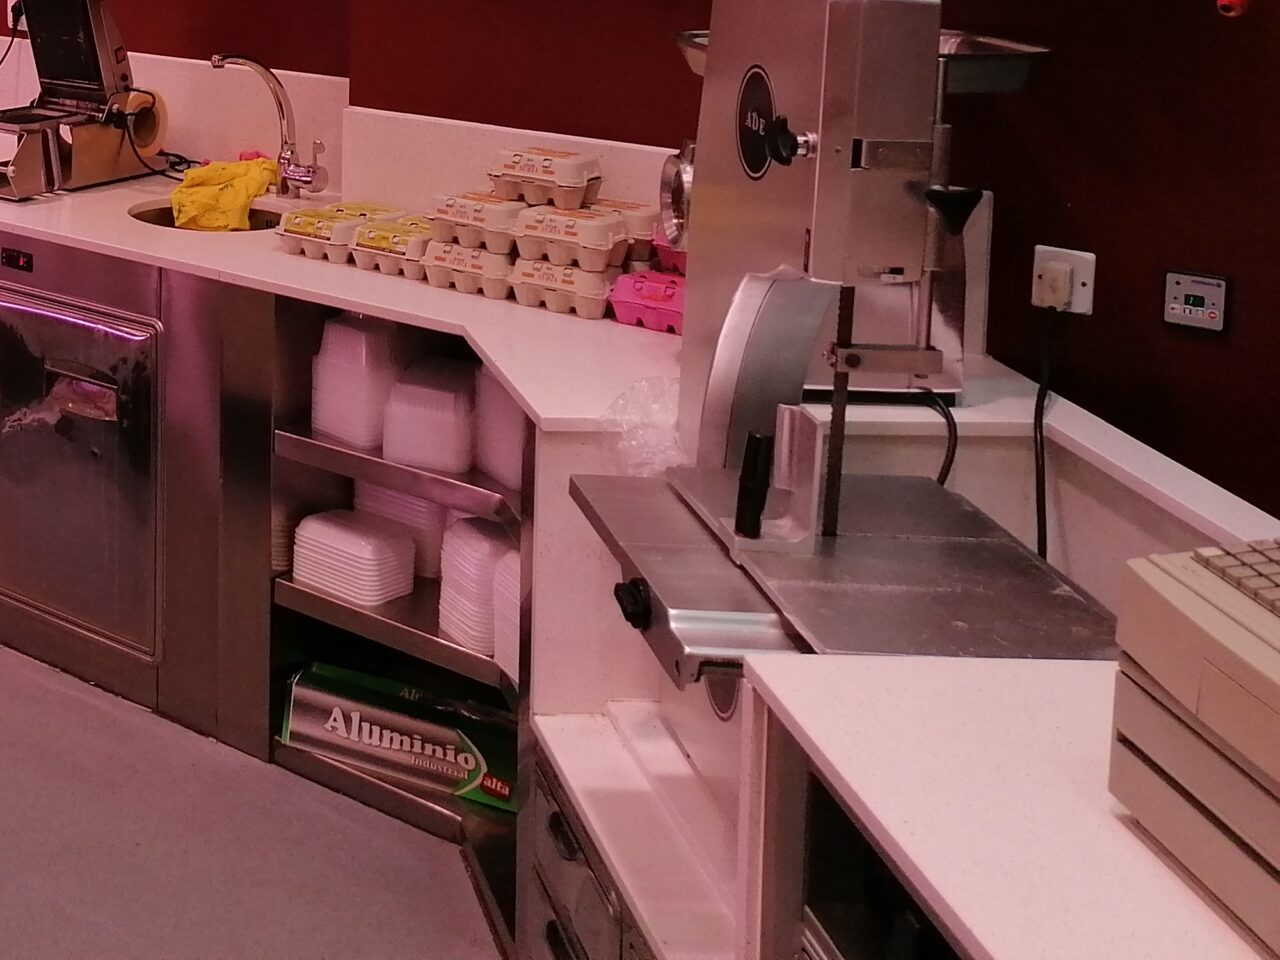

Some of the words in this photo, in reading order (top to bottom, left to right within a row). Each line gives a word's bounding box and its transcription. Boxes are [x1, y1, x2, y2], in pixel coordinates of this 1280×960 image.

[744, 110, 766, 136] ADE
[323, 706, 477, 771] Aluminio
[411, 755, 469, 781] Industrial
[483, 775, 510, 797] alta
